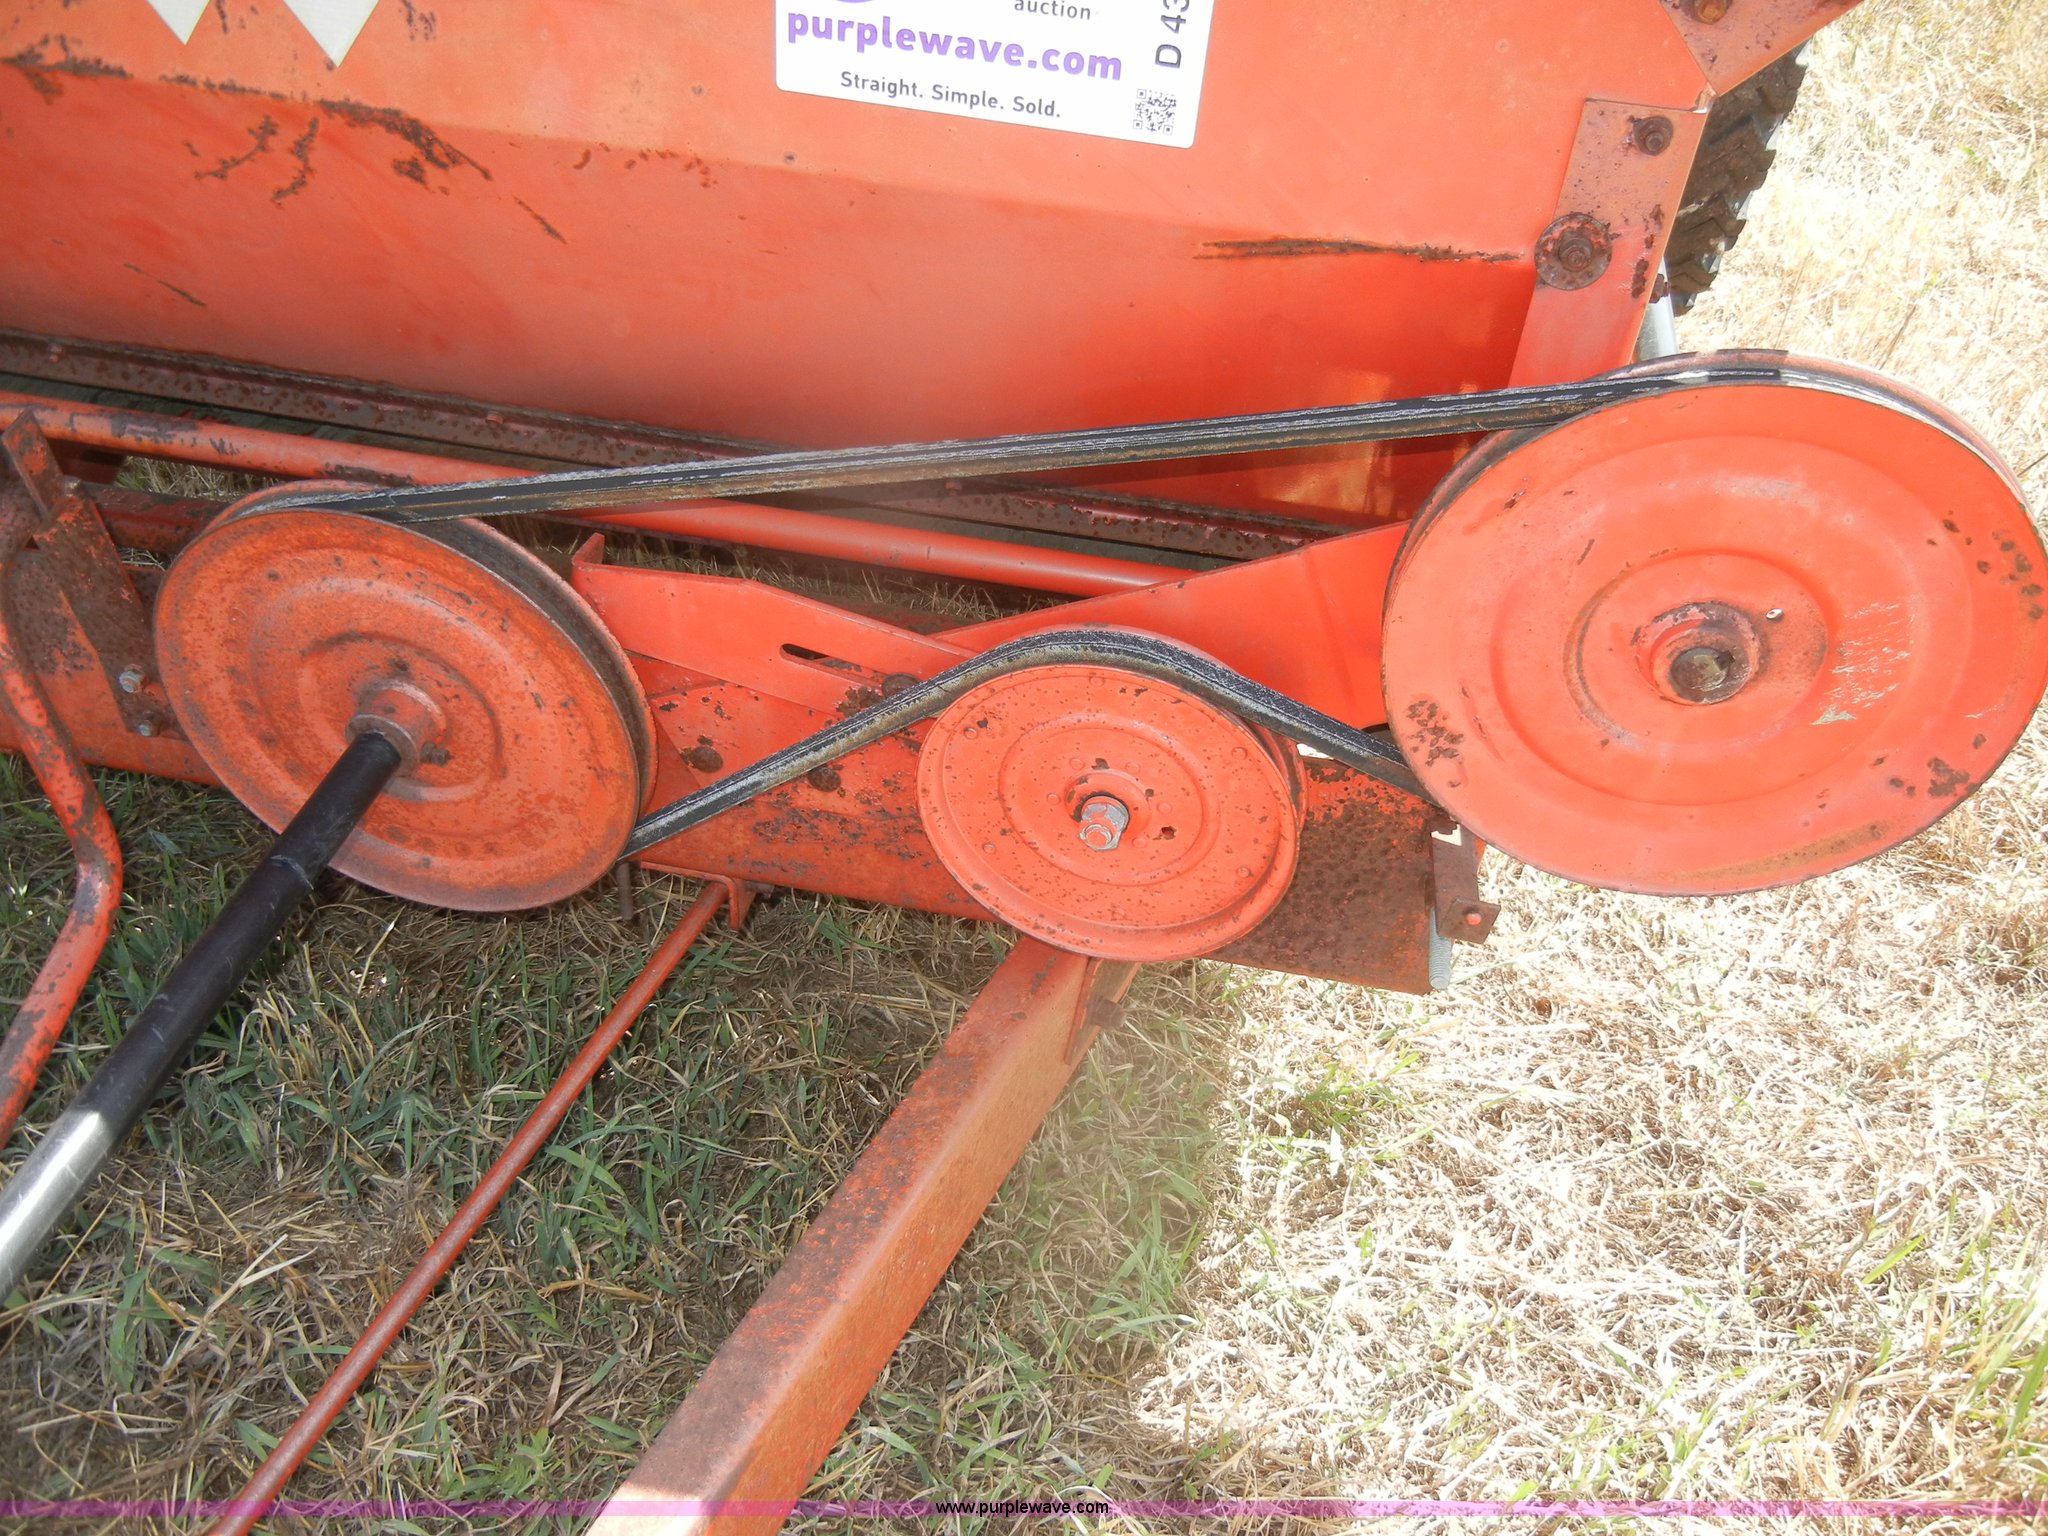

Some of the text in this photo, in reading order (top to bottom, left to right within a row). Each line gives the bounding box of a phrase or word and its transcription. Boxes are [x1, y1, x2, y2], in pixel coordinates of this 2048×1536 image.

[1014, 0, 1091, 20] auction
[788, 12, 1122, 80] purplewave.com
[1155, 44, 1182, 69] D
[840, 71, 1061, 118] Straight. Simple. Sold.
